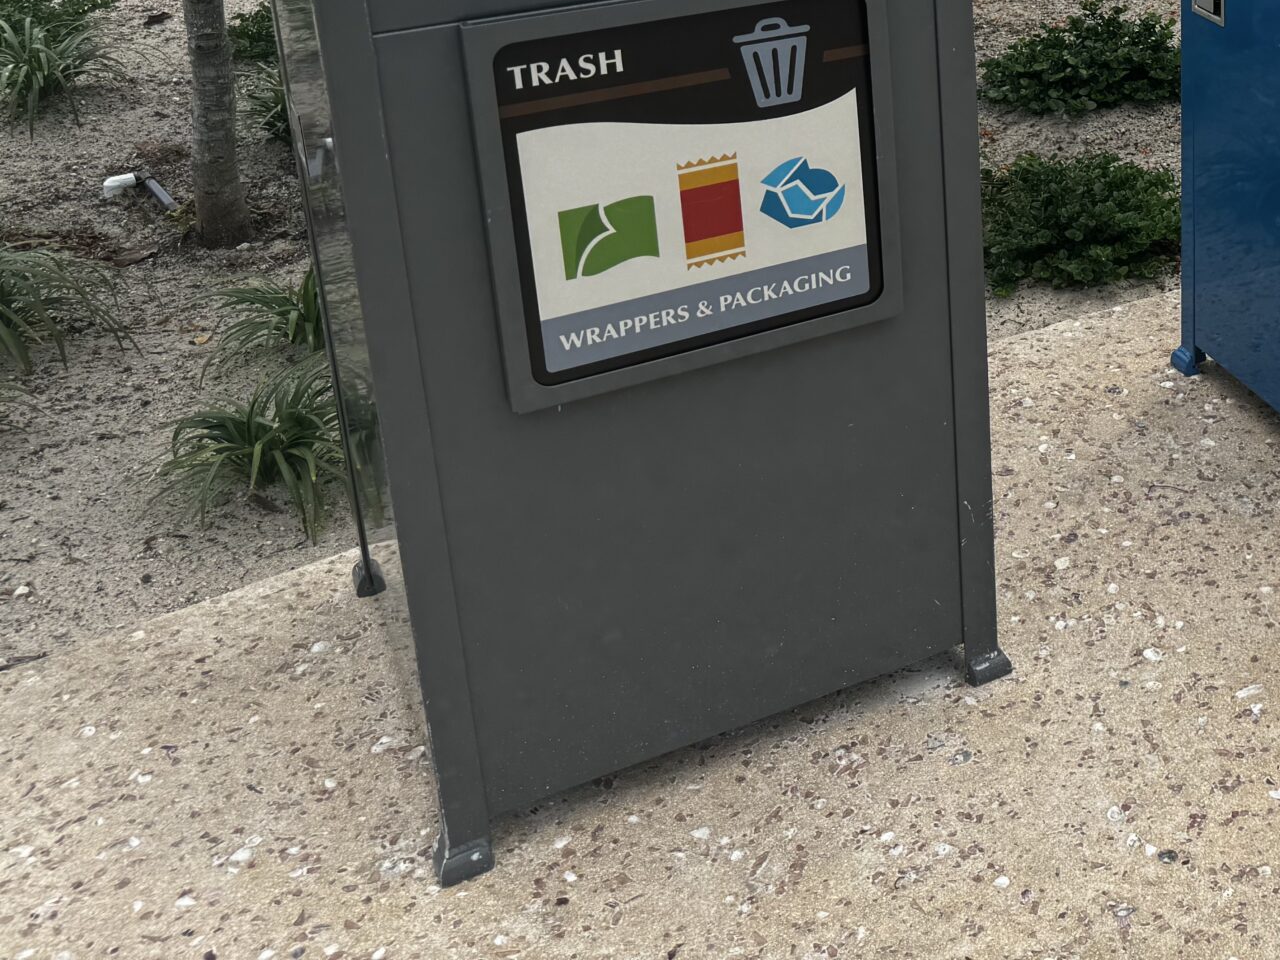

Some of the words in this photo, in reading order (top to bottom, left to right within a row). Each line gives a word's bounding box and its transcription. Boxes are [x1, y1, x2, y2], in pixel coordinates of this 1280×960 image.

[506, 49, 625, 90] TRASH
[559, 305, 690, 351] WRAPPERS
[696, 299, 714, 317] &
[719, 265, 852, 313] PACKAGING
